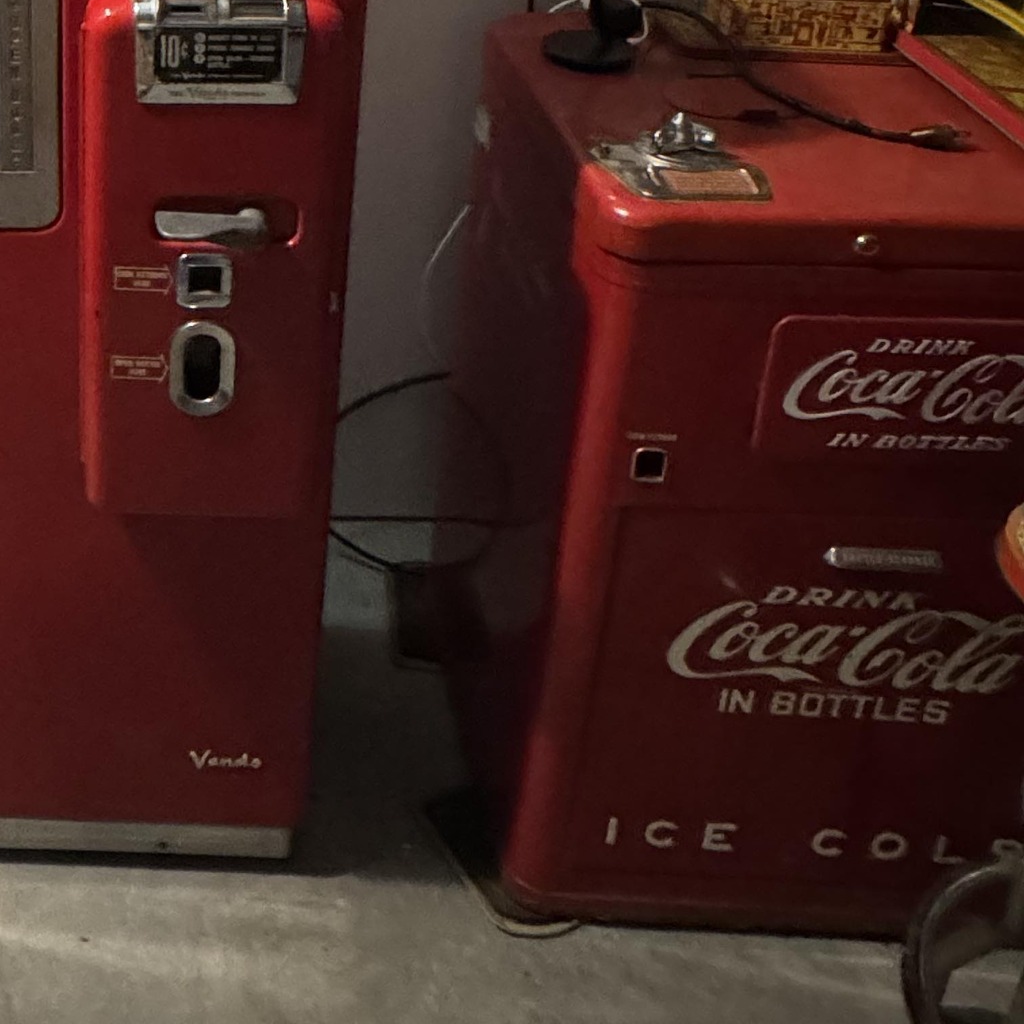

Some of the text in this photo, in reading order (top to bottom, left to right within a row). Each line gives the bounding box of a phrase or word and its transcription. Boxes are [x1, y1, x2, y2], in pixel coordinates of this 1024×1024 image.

[866, 338, 976, 356] DRINK
[782, 349, 1024, 425] Coca-Col
[827, 432, 1013, 452] IN BOTTLES
[762, 585, 925, 611] DRINK
[666, 600, 1024, 694] Coca-Cola
[718, 687, 952, 725] IN BOTTLES
[605, 816, 738, 853] ICE
